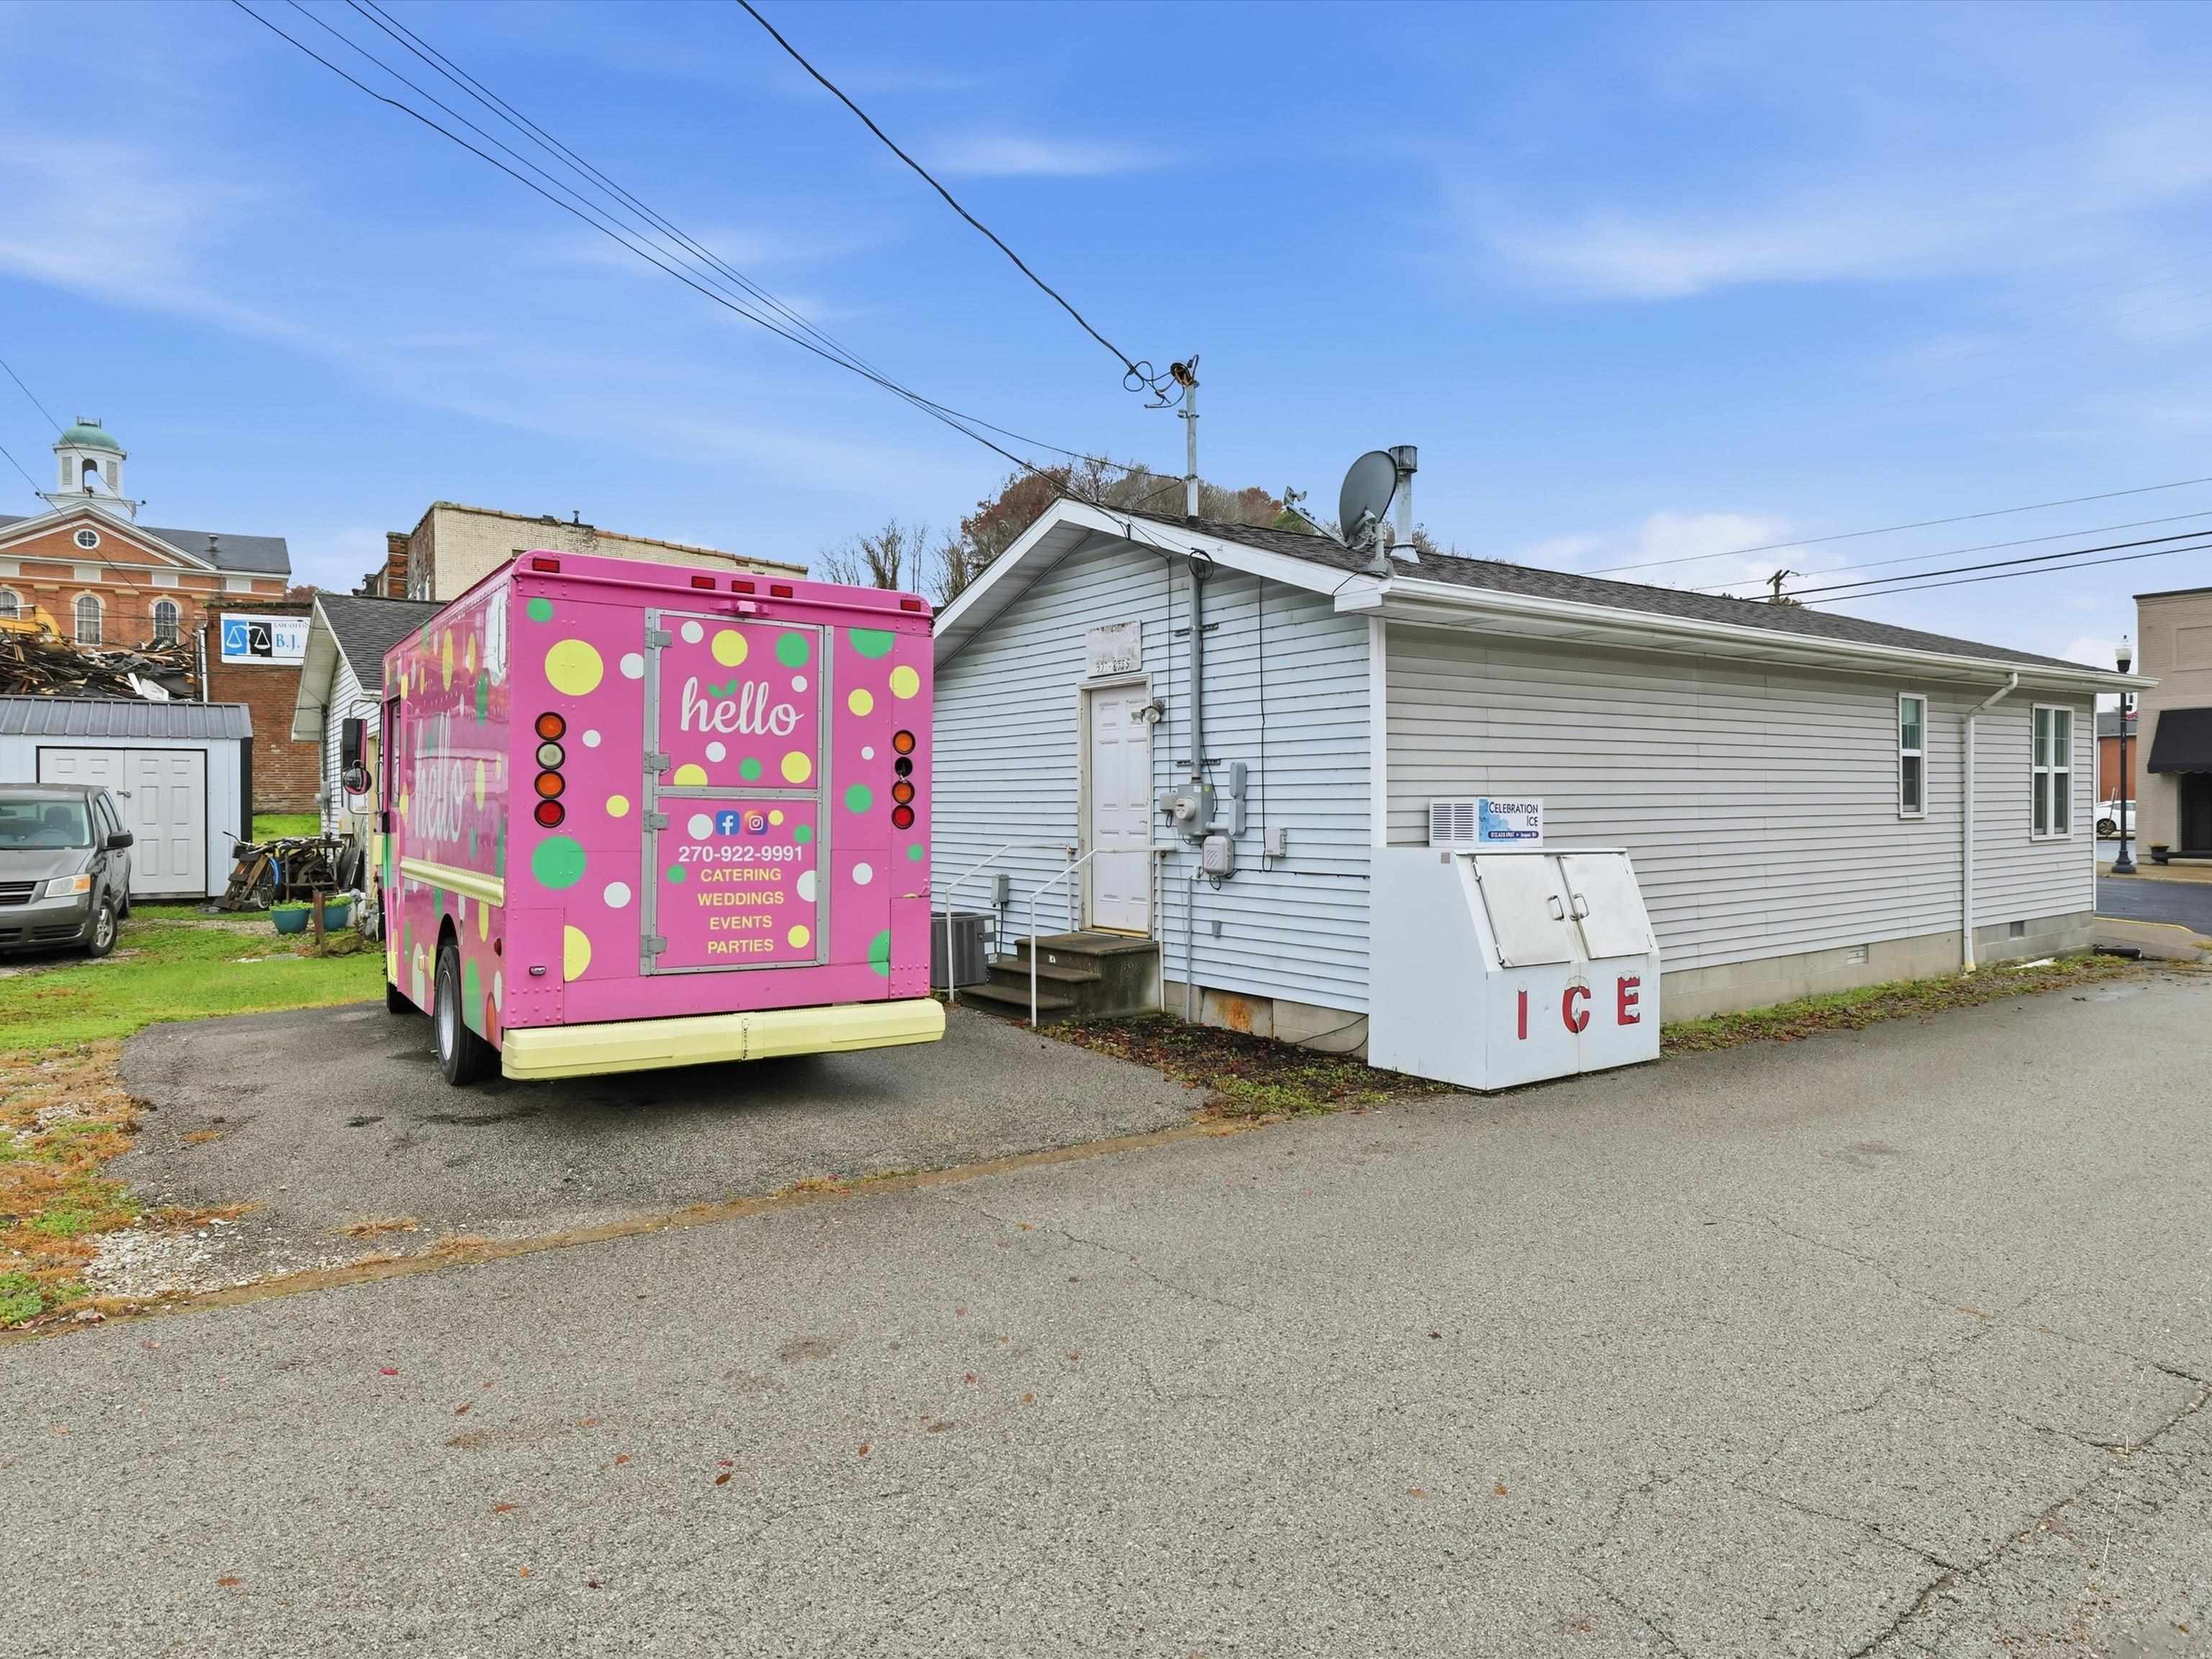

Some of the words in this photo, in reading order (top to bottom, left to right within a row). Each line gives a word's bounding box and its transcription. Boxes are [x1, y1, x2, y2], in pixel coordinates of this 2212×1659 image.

[276, 634, 300, 651] B.J.
[680, 676, 804, 736] hello
[415, 709, 467, 843] hello
[678, 845, 803, 863] 270-922-9991
[700, 868, 782, 883] CATERING
[697, 891, 784, 907] WEDDINGS
[709, 915, 773, 930] EVENTS
[708, 939, 774, 954] PARTIES
[1516, 970, 1642, 1040] ICE
